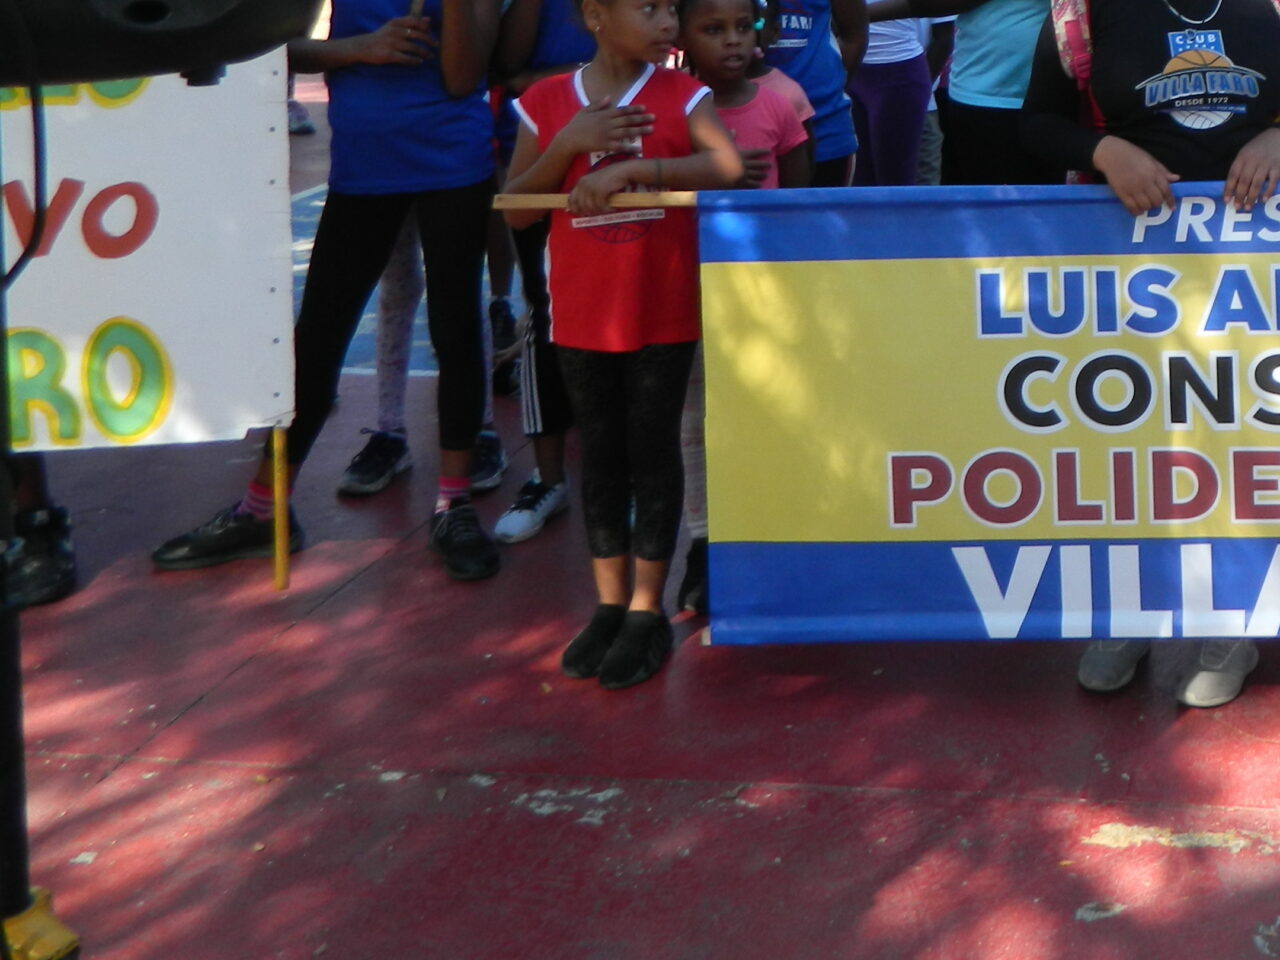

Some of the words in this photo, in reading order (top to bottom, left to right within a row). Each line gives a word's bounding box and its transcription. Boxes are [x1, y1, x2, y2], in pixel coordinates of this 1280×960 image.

[1175, 33, 1216, 45] CLUB
[1145, 71, 1206, 107] VILLA
[1206, 71, 1260, 98] FARO
[1174, 98, 1205, 107] DESDE
[977, 264, 1181, 337] LUIS
